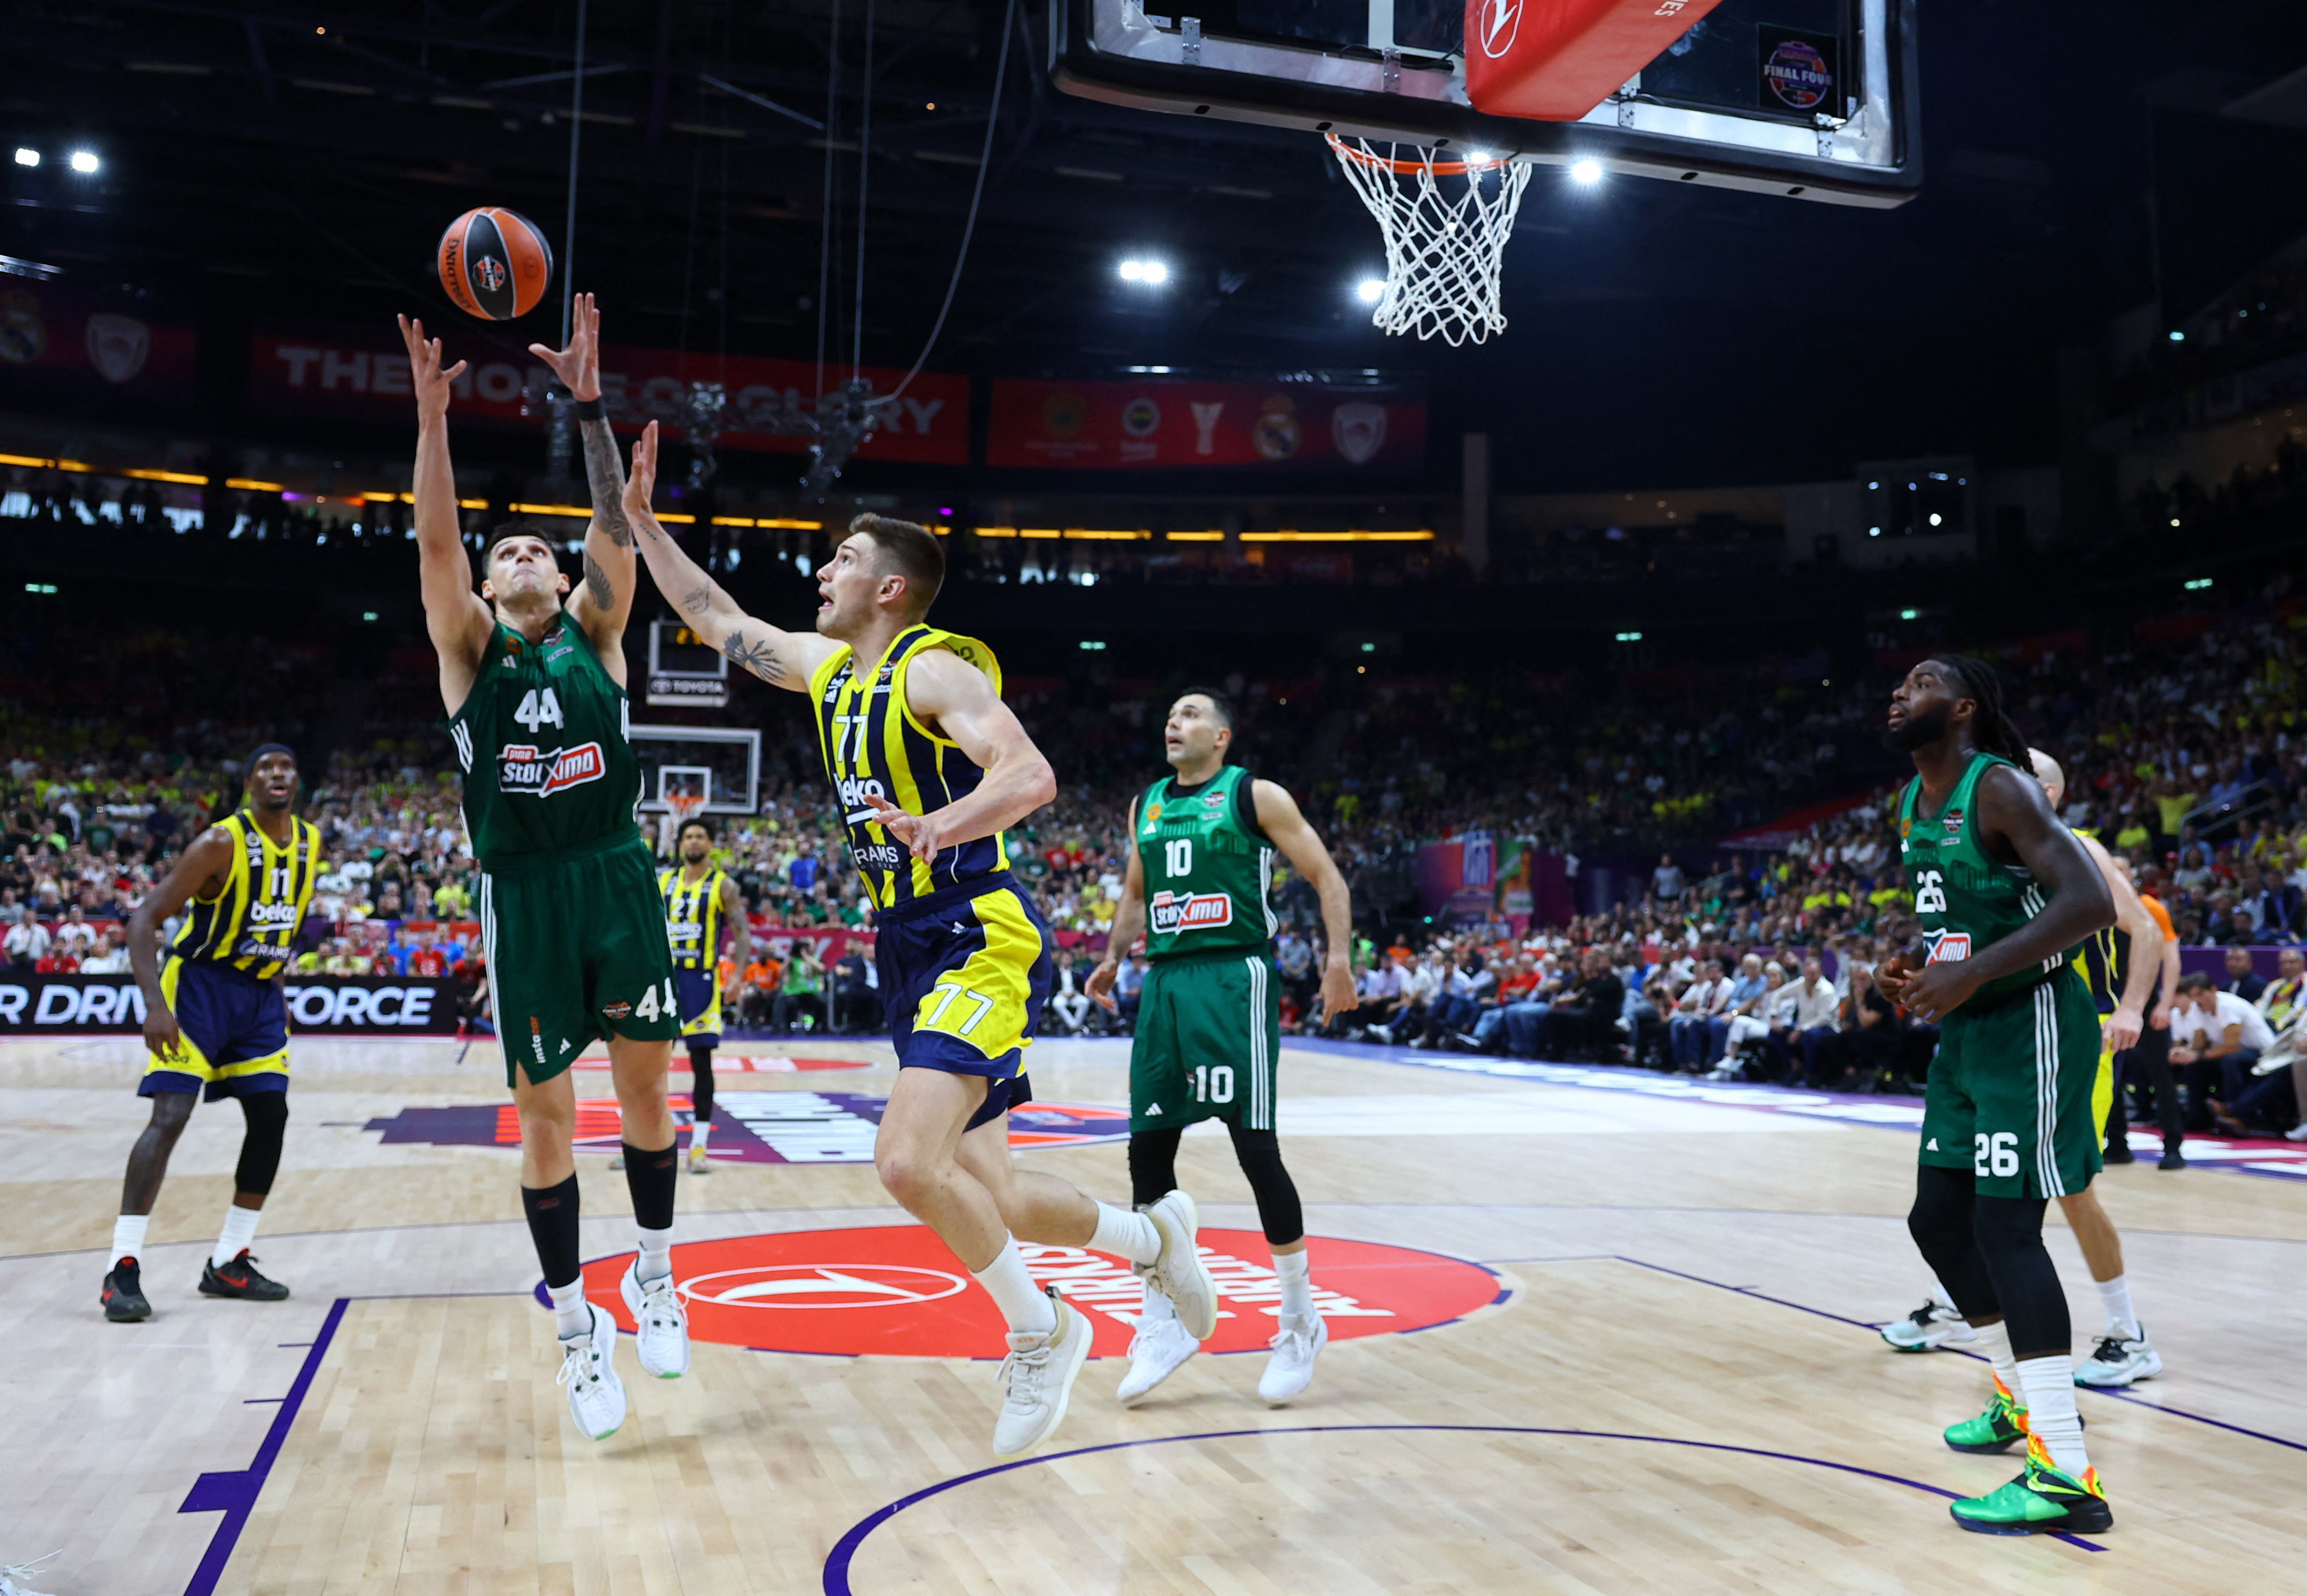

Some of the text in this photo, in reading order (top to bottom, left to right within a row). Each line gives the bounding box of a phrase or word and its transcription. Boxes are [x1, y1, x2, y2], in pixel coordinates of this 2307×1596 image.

[1764, 64, 1800, 81] FINAL
[1801, 70, 1832, 86] FOUR
[276, 346, 412, 394] THE
[673, 680, 724, 694] TOYOTA
[514, 687, 565, 733] 44
[835, 714, 868, 763] 77
[834, 773, 885, 807] beko
[854, 846, 899, 865] RAMS
[1165, 838, 1192, 878] 10
[270, 867, 290, 897] 11
[1915, 870, 1947, 913] 26
[251, 899, 296, 922] beko
[671, 897, 699, 918] 27
[635, 976, 677, 1023] 44
[926, 982, 994, 1036] 77
[1196, 1065, 1234, 1103] 10
[1974, 1132, 2019, 1177] 26
